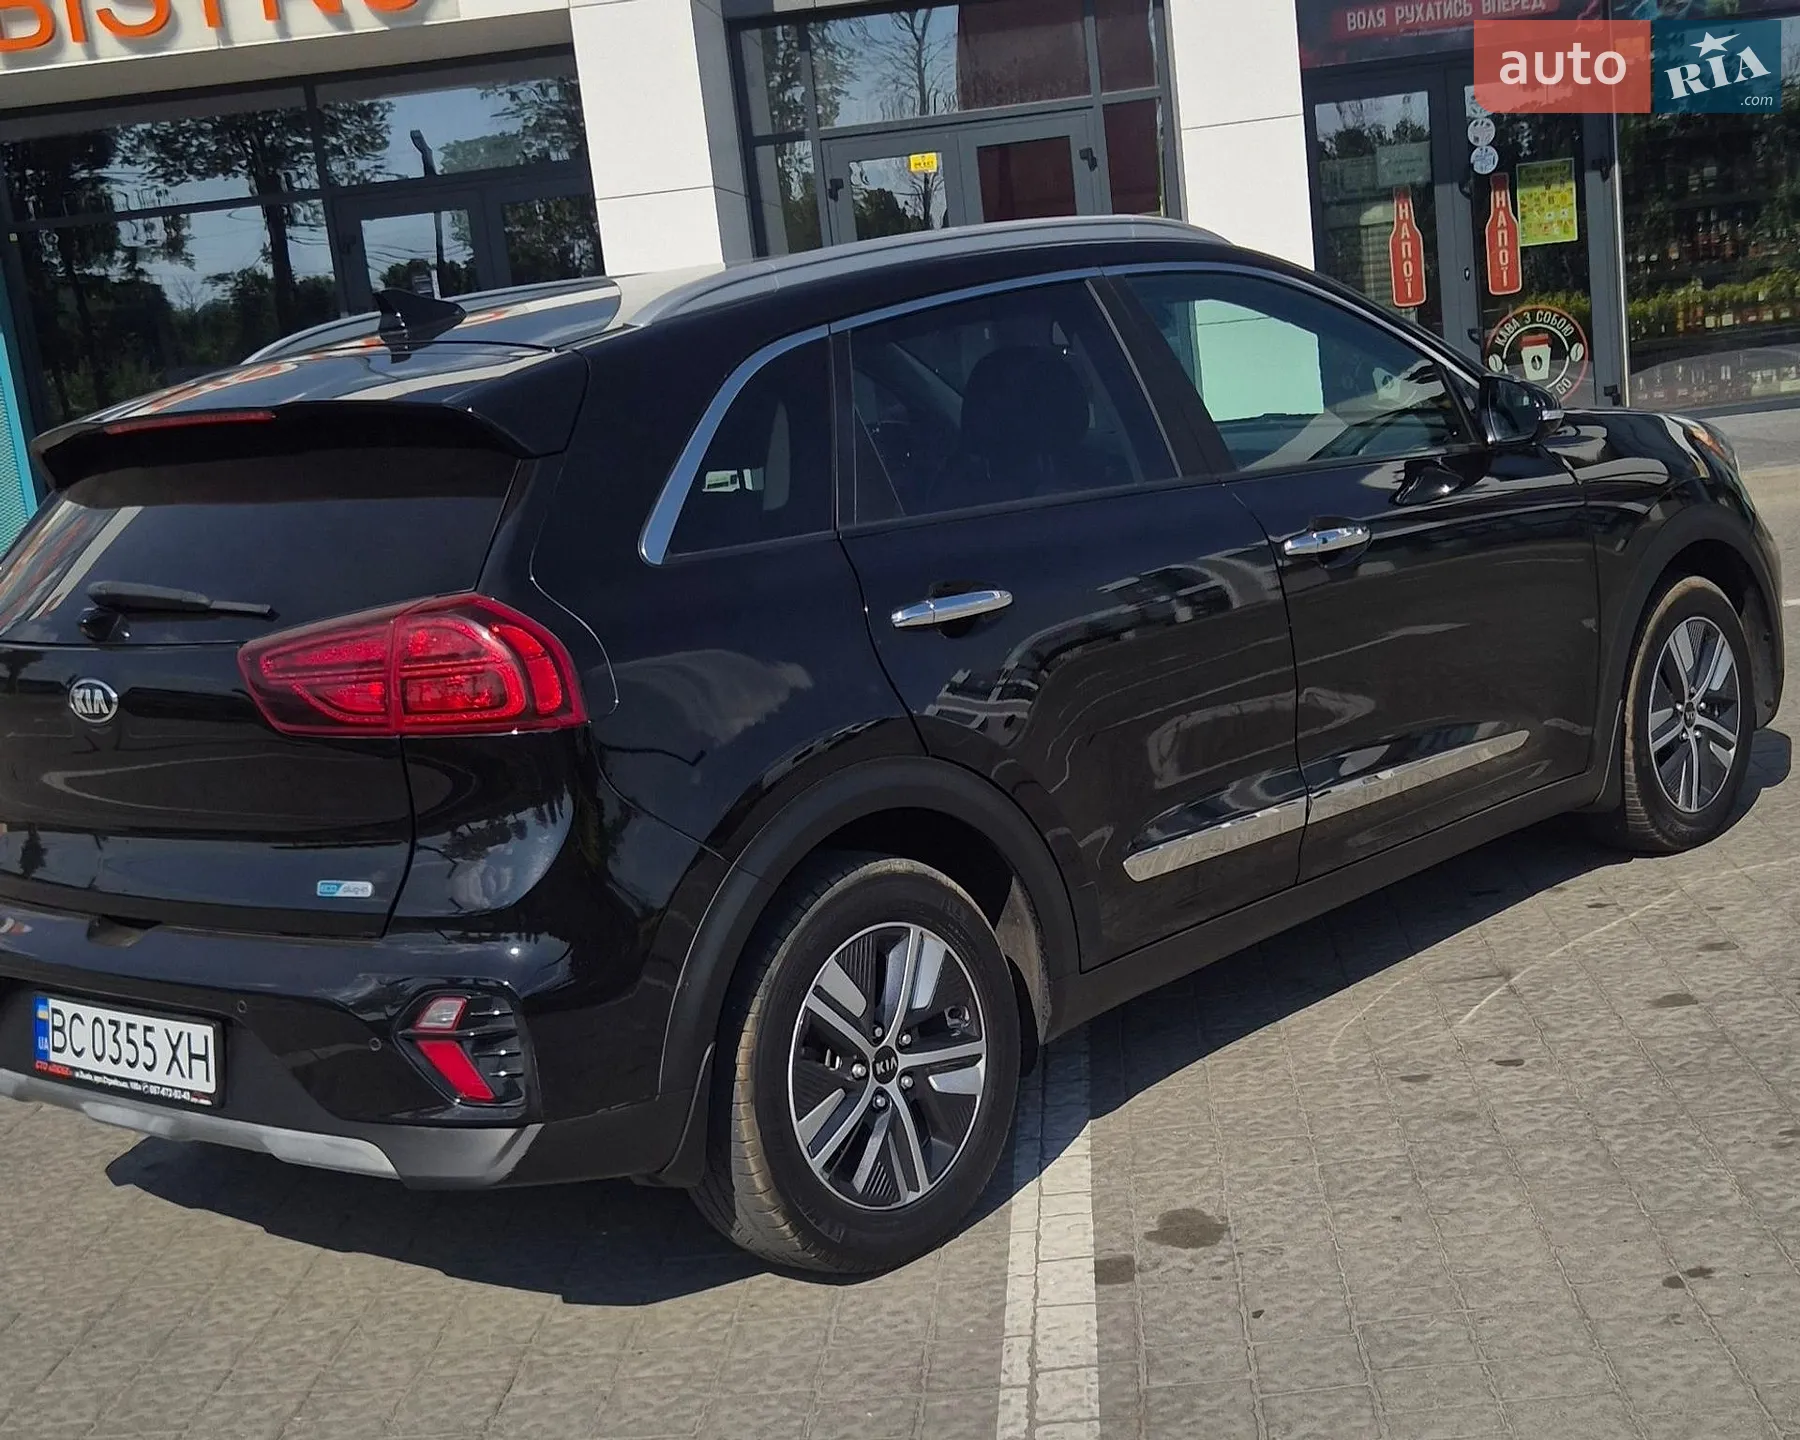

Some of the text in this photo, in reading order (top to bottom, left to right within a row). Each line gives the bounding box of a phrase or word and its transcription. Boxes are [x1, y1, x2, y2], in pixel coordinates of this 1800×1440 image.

[1347, 7, 1386, 32] ВОЛЯ
[1395, 0, 1473, 25] РУХАТИСЬ
[1398, 203, 1413, 299] НАПОЇ
[1495, 190, 1508, 287] НАПОЇ
[1495, 318, 1521, 347] КАВА
[1536, 310, 1575, 337] СОБОЮ
[1555, 377, 1572, 395] GO
[73, 688, 109, 714] KIA
[38, 1036, 49, 1050] UA
[50, 1007, 86, 1059] BC
[91, 1016, 158, 1072] 0355
[164, 1028, 210, 1083] XH
[876, 1057, 897, 1074] KIA
